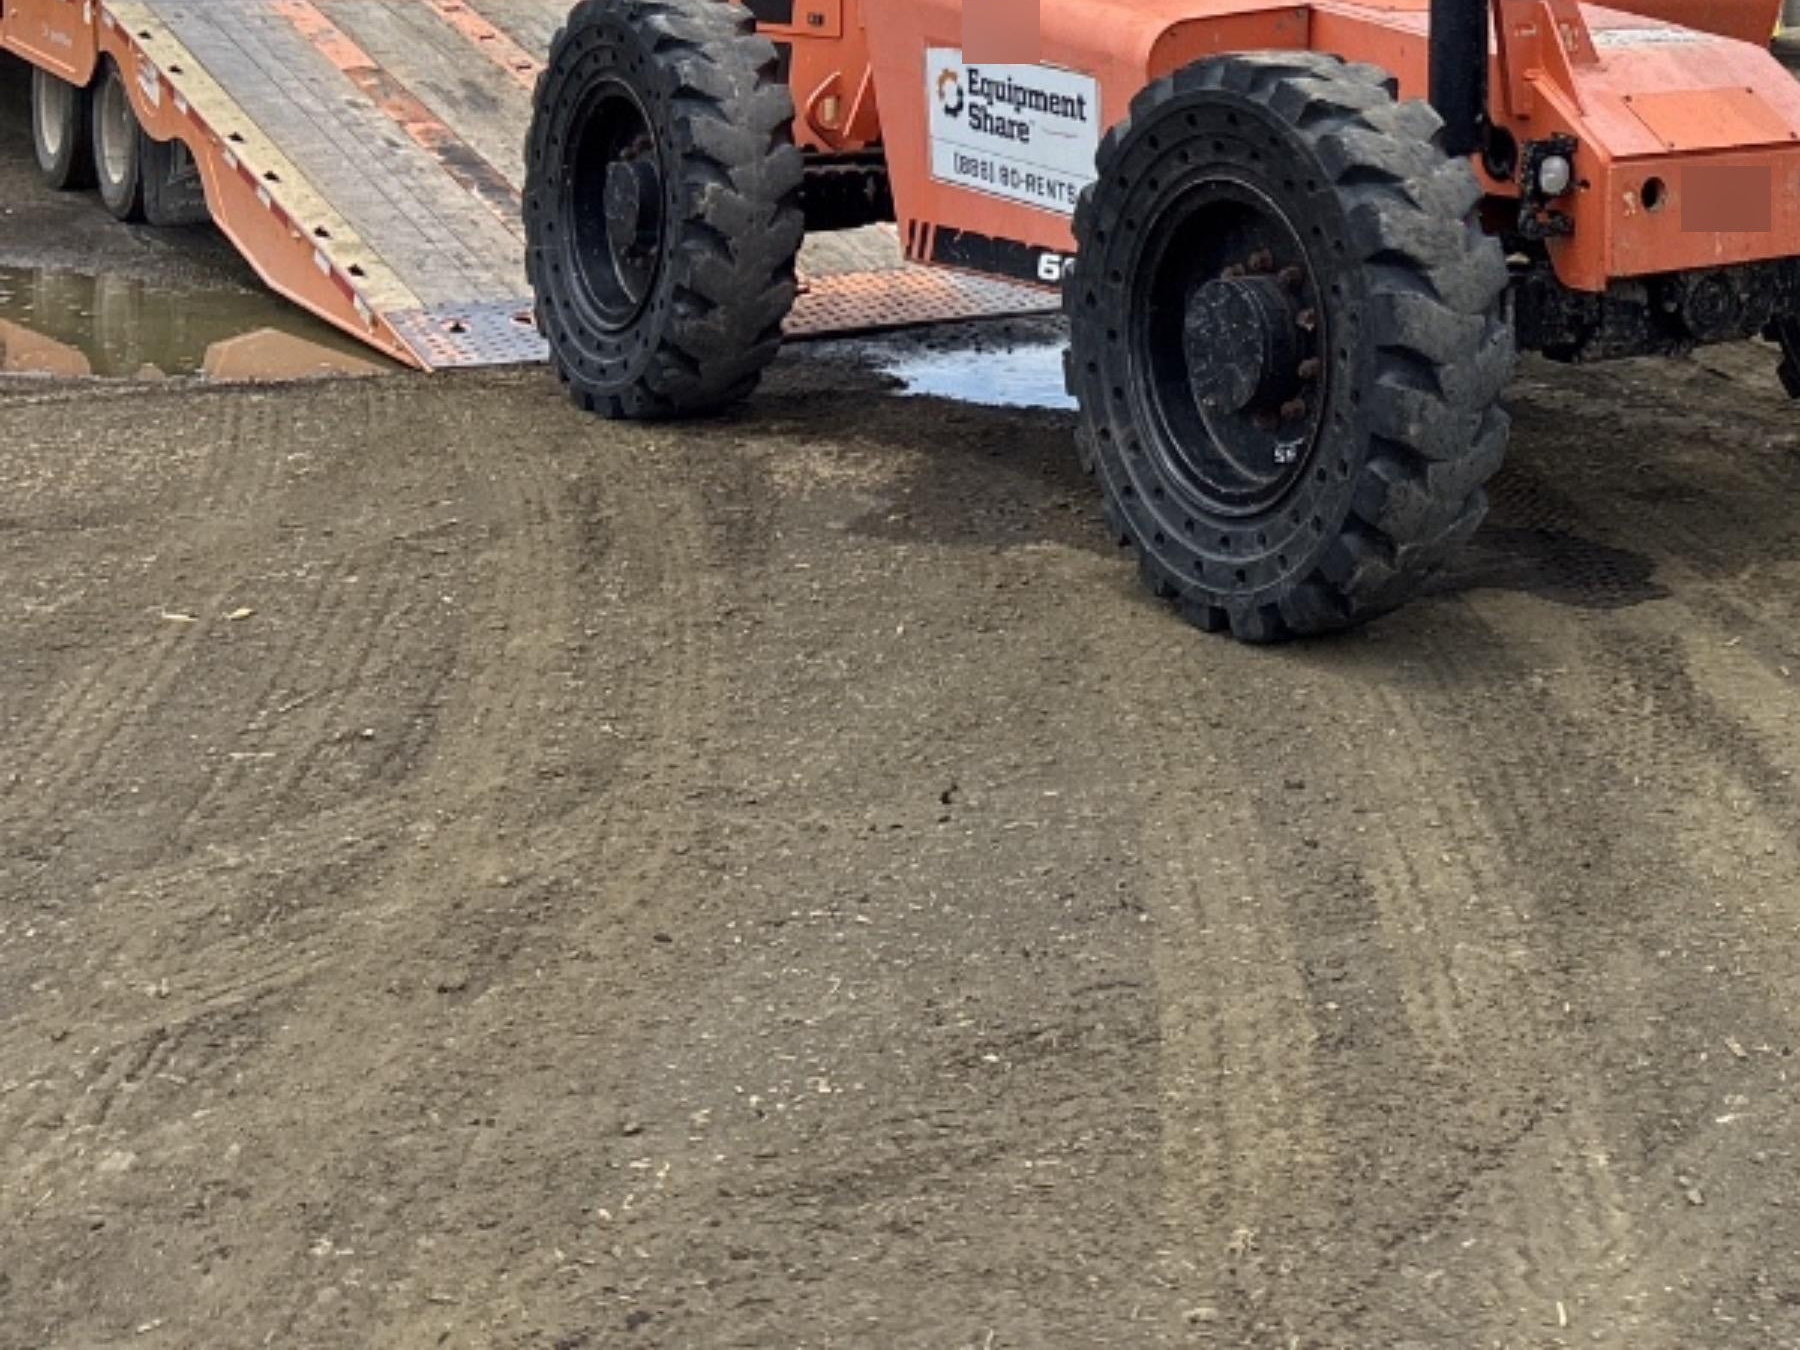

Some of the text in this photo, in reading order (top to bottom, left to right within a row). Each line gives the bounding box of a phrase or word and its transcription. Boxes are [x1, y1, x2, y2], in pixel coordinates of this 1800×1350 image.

[966, 68, 1087, 123] Equipment
[967, 102, 1031, 143] Share
[998, 164, 1077, 205] 80-RENTS
